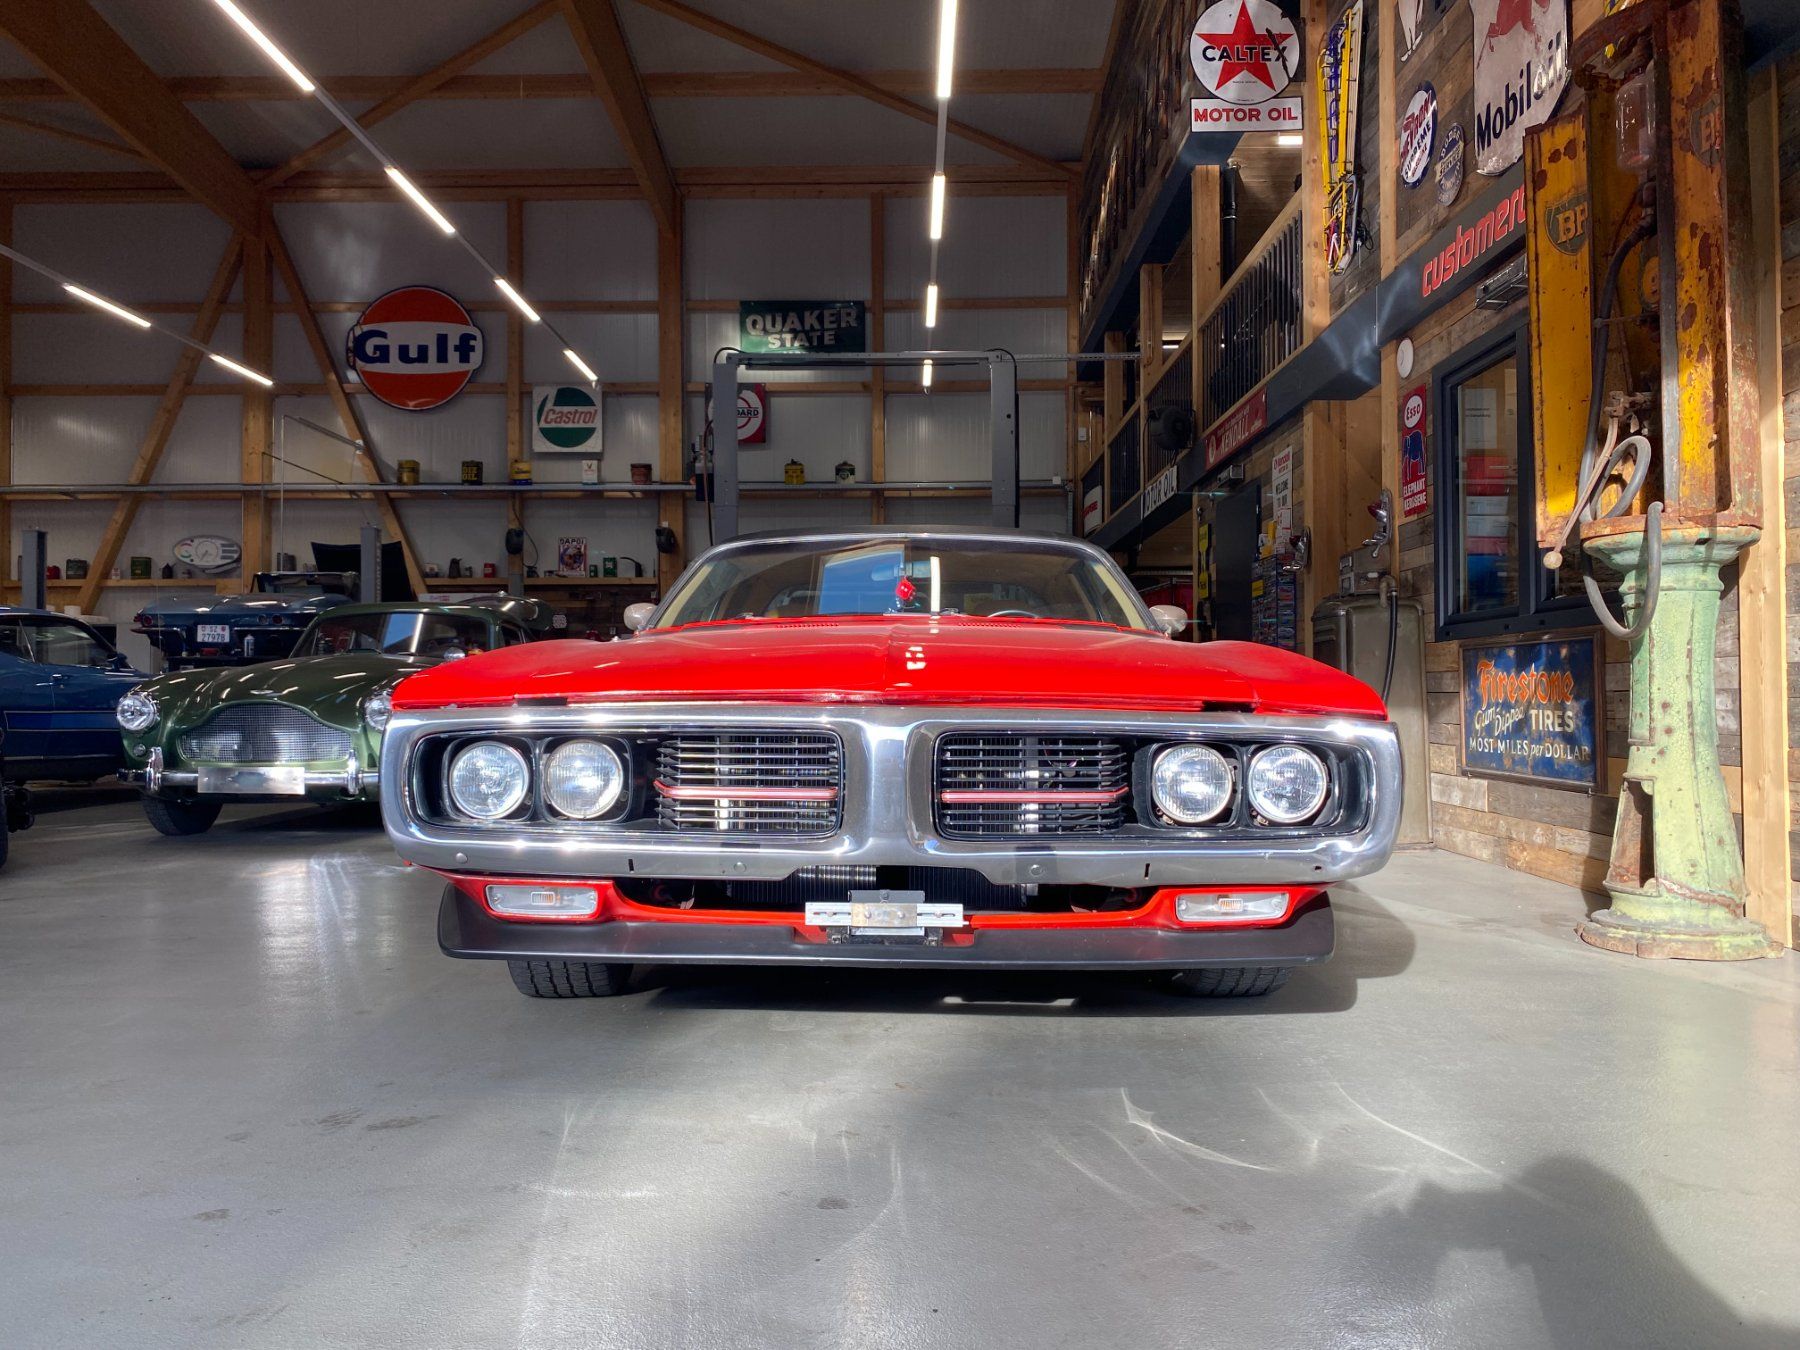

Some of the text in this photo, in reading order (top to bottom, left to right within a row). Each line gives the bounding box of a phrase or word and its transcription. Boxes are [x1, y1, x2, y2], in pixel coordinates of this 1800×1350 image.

[1202, 45, 1288, 62] CALTEX
[1194, 107, 1298, 122] MOTOR OIL
[1556, 201, 1588, 244] BP
[746, 308, 858, 336] QUAKER
[353, 329, 477, 364] Gulf
[767, 330, 837, 349] STATE
[544, 408, 598, 425] Castrol
[1163, 467, 1176, 498] OIL
[1403, 478, 1426, 498] ELEPHANT
[1477, 659, 1575, 710] Firestone
[1529, 709, 1575, 733] TIRES
[1469, 737, 1591, 761] MOST MILES per DOLLAR
